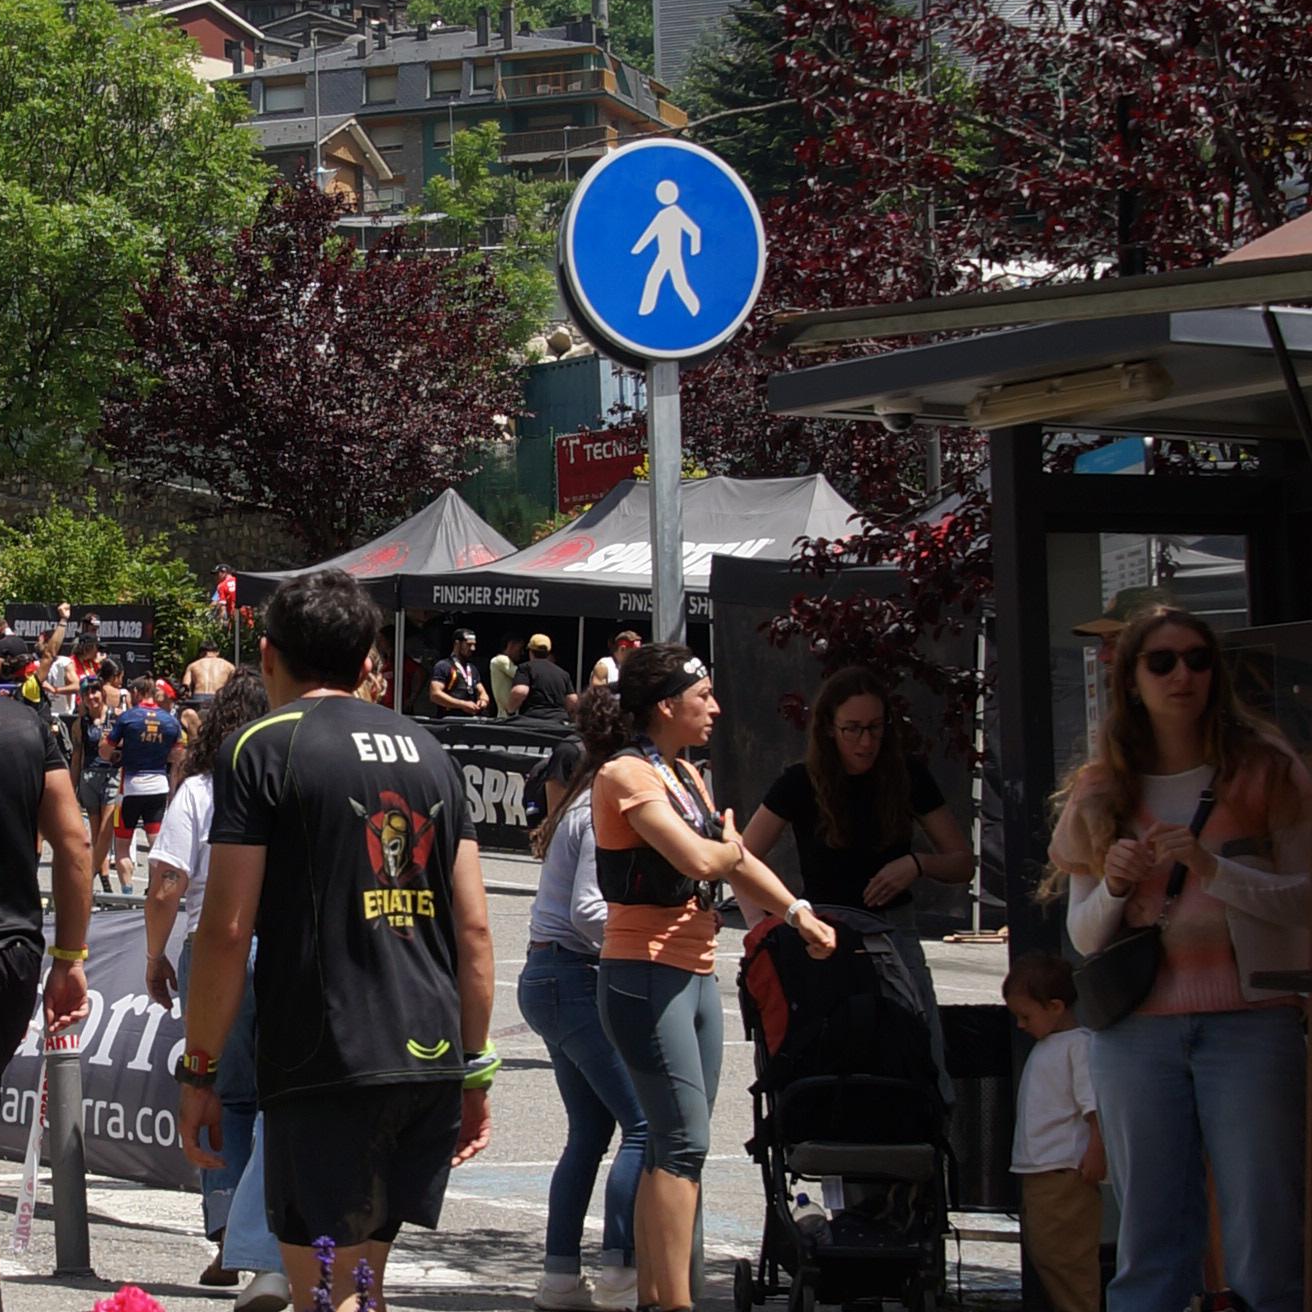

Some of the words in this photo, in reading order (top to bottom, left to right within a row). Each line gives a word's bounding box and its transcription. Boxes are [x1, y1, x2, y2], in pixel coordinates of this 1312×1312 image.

[433, 585, 491, 606] FINISHER
[494, 587, 539, 608] SHIRTS
[619, 593, 653, 612] FINIS
[351, 732, 420, 763] EDU
